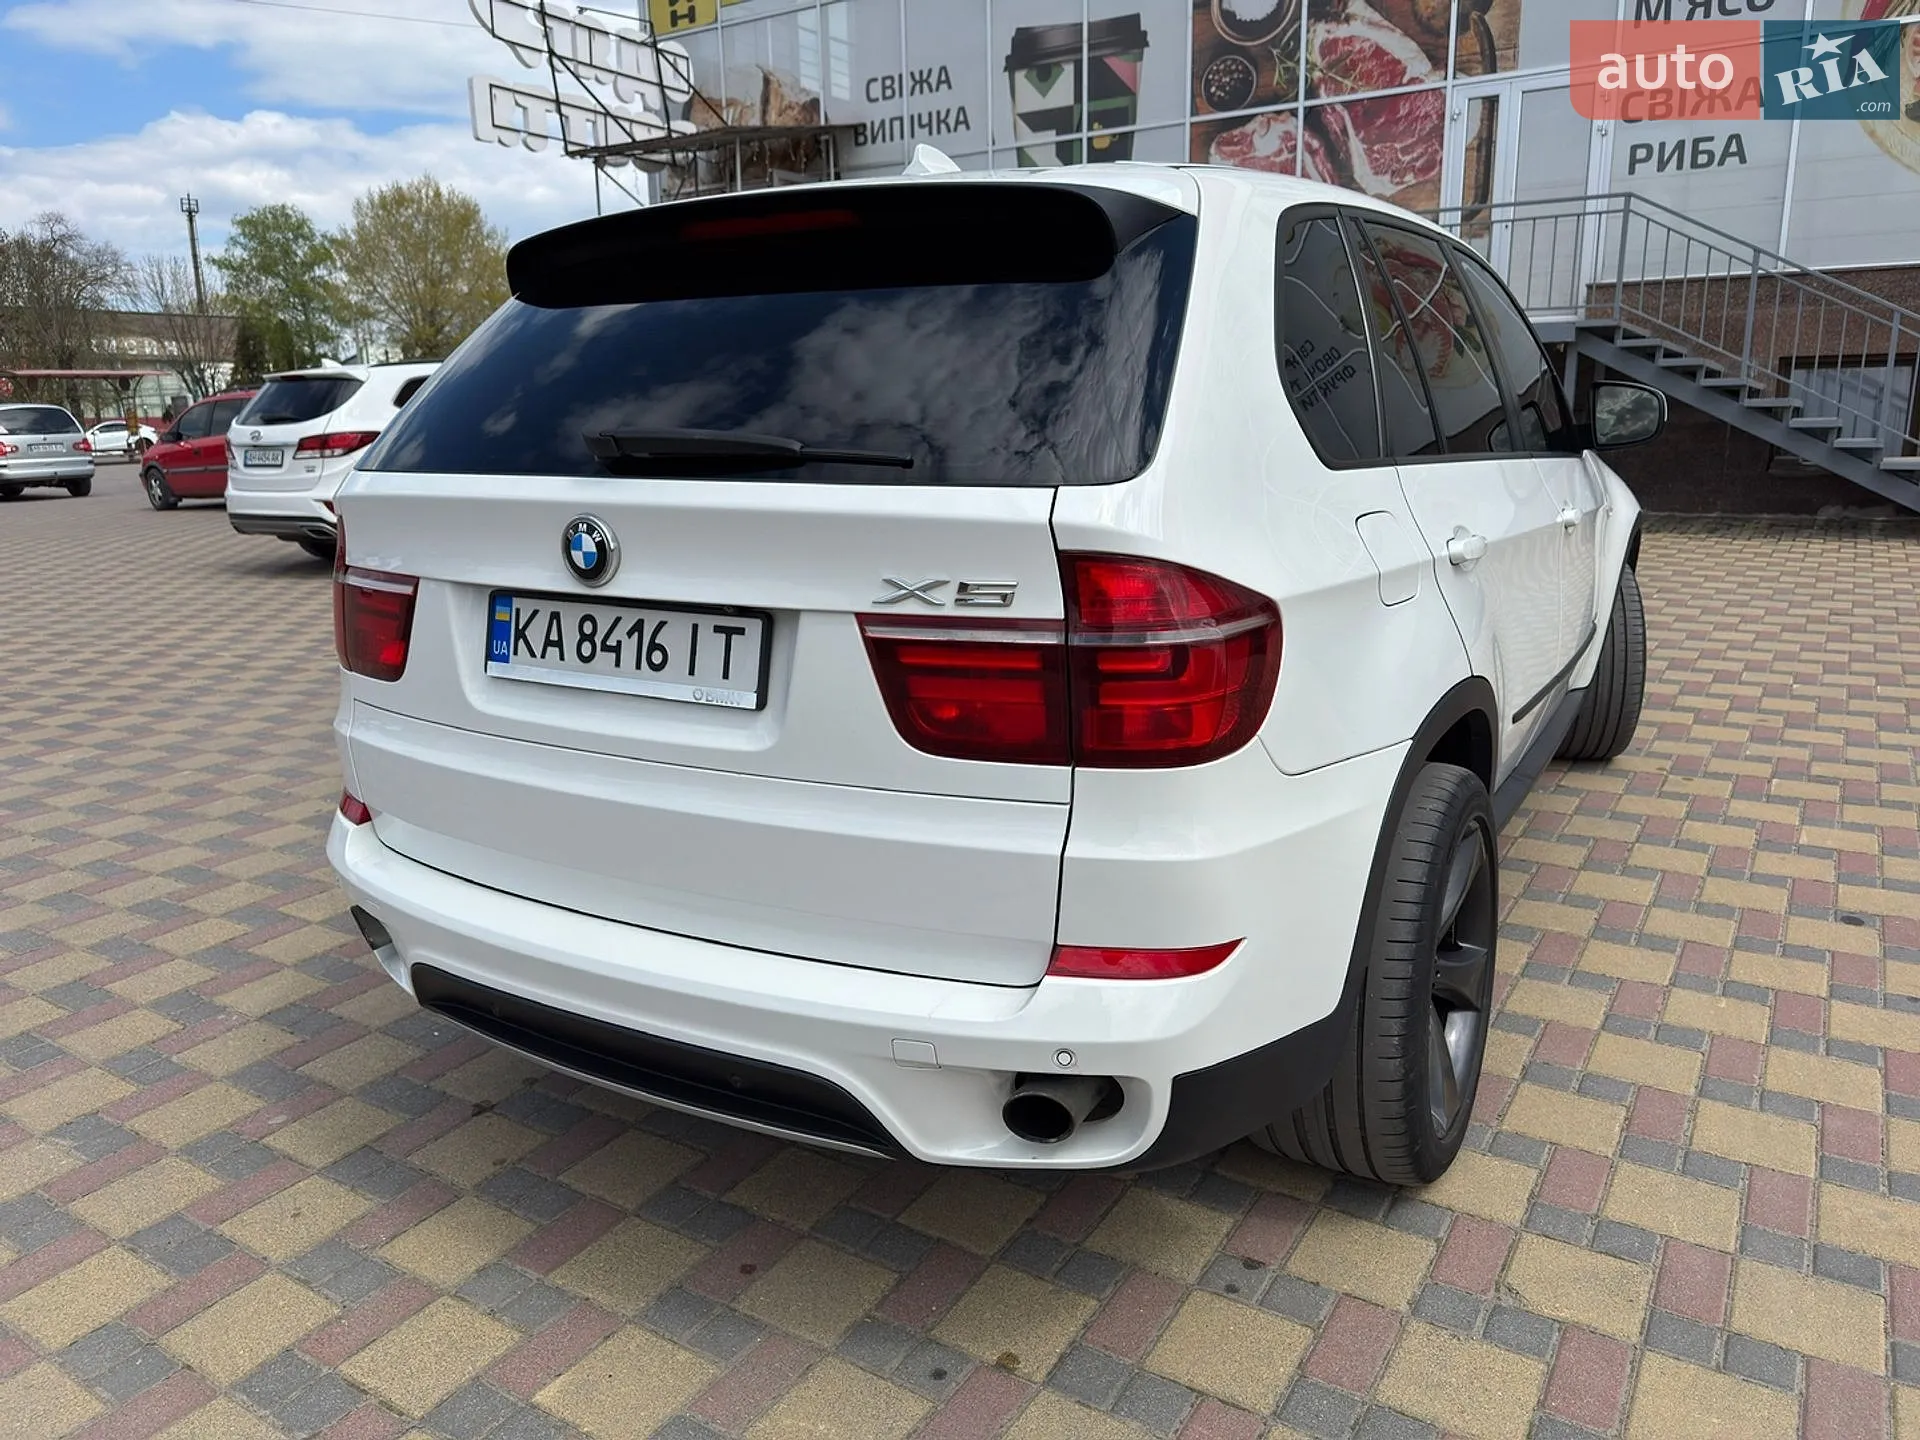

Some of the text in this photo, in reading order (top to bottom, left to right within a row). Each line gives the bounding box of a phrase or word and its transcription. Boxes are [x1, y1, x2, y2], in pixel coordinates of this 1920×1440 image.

[1634, 0, 1775, 28] МЯС
[865, 65, 952, 103] СВІЖА
[1621, 76, 1764, 124] СВІЖА
[853, 105, 971, 147] ВИПІЧКА
[1628, 133, 1747, 175] РИБА
[567, 523, 602, 543] BMW
[872, 577, 1019, 607] X5
[493, 639, 508, 656] UA
[513, 607, 746, 680] KA 8416 IT
